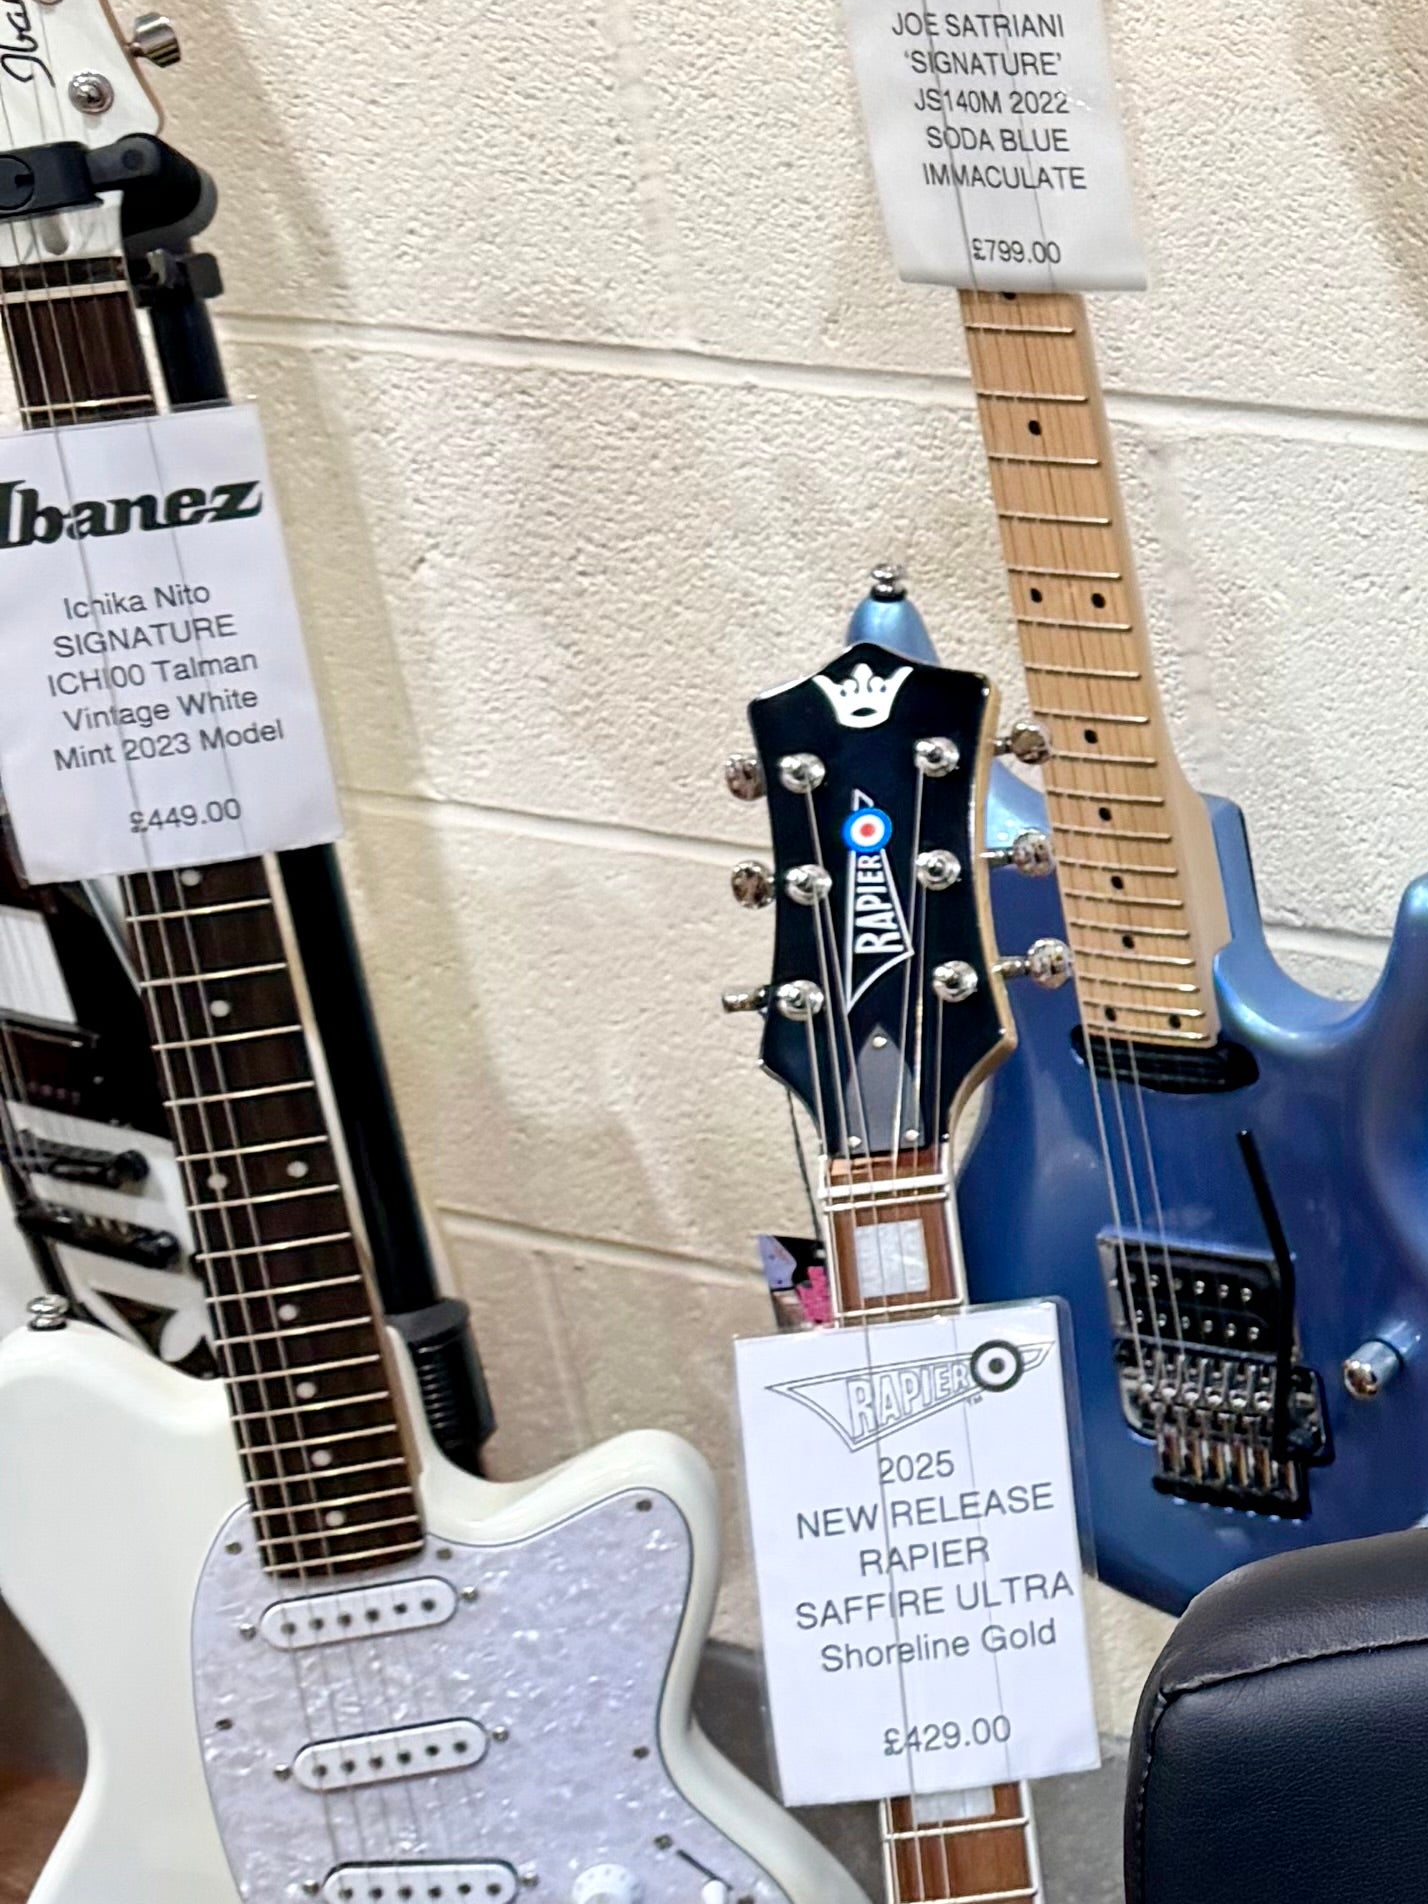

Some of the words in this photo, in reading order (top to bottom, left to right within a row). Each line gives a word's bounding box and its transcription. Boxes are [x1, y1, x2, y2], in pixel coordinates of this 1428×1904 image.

[891, 12, 940, 38] JOE
[945, 13, 1066, 38] SATRIANI
[914, 90, 1002, 115] JS140M
[1009, 91, 1071, 115] 2022
[927, 126, 994, 152] SODA
[1000, 128, 1071, 153] BLUE
[923, 162, 1088, 191] IMMACULATE
[972, 238, 1062, 265] £799.00
[0, 480, 263, 549] Ibanez
[63, 590, 147, 622] Ichika
[154, 584, 211, 609] Nito
[53, 614, 238, 659] SIGNATURE
[151, 651, 259, 685] Talman
[62, 701, 170, 734] Vintage
[177, 688, 259, 717] White
[54, 743, 116, 772] Mint
[122, 735, 192, 763] 2023
[200, 718, 285, 750] Model
[129, 797, 242, 834] £449.00
[855, 853, 902, 955] RAPIER
[847, 1361, 973, 1439] RAPIER
[879, 1450, 955, 1484] 2025
[796, 1504, 878, 1540] NEW
[891, 1482, 1055, 1529] RELEASE
[859, 1536, 989, 1577] RAPIER
[796, 1587, 945, 1631] SAFFIRE
[956, 1570, 1074, 1610] ULTRA
[821, 1633, 970, 1673] Shoreline
[980, 1618, 1057, 1654] Gold
[883, 1715, 1012, 1757] £429.00
